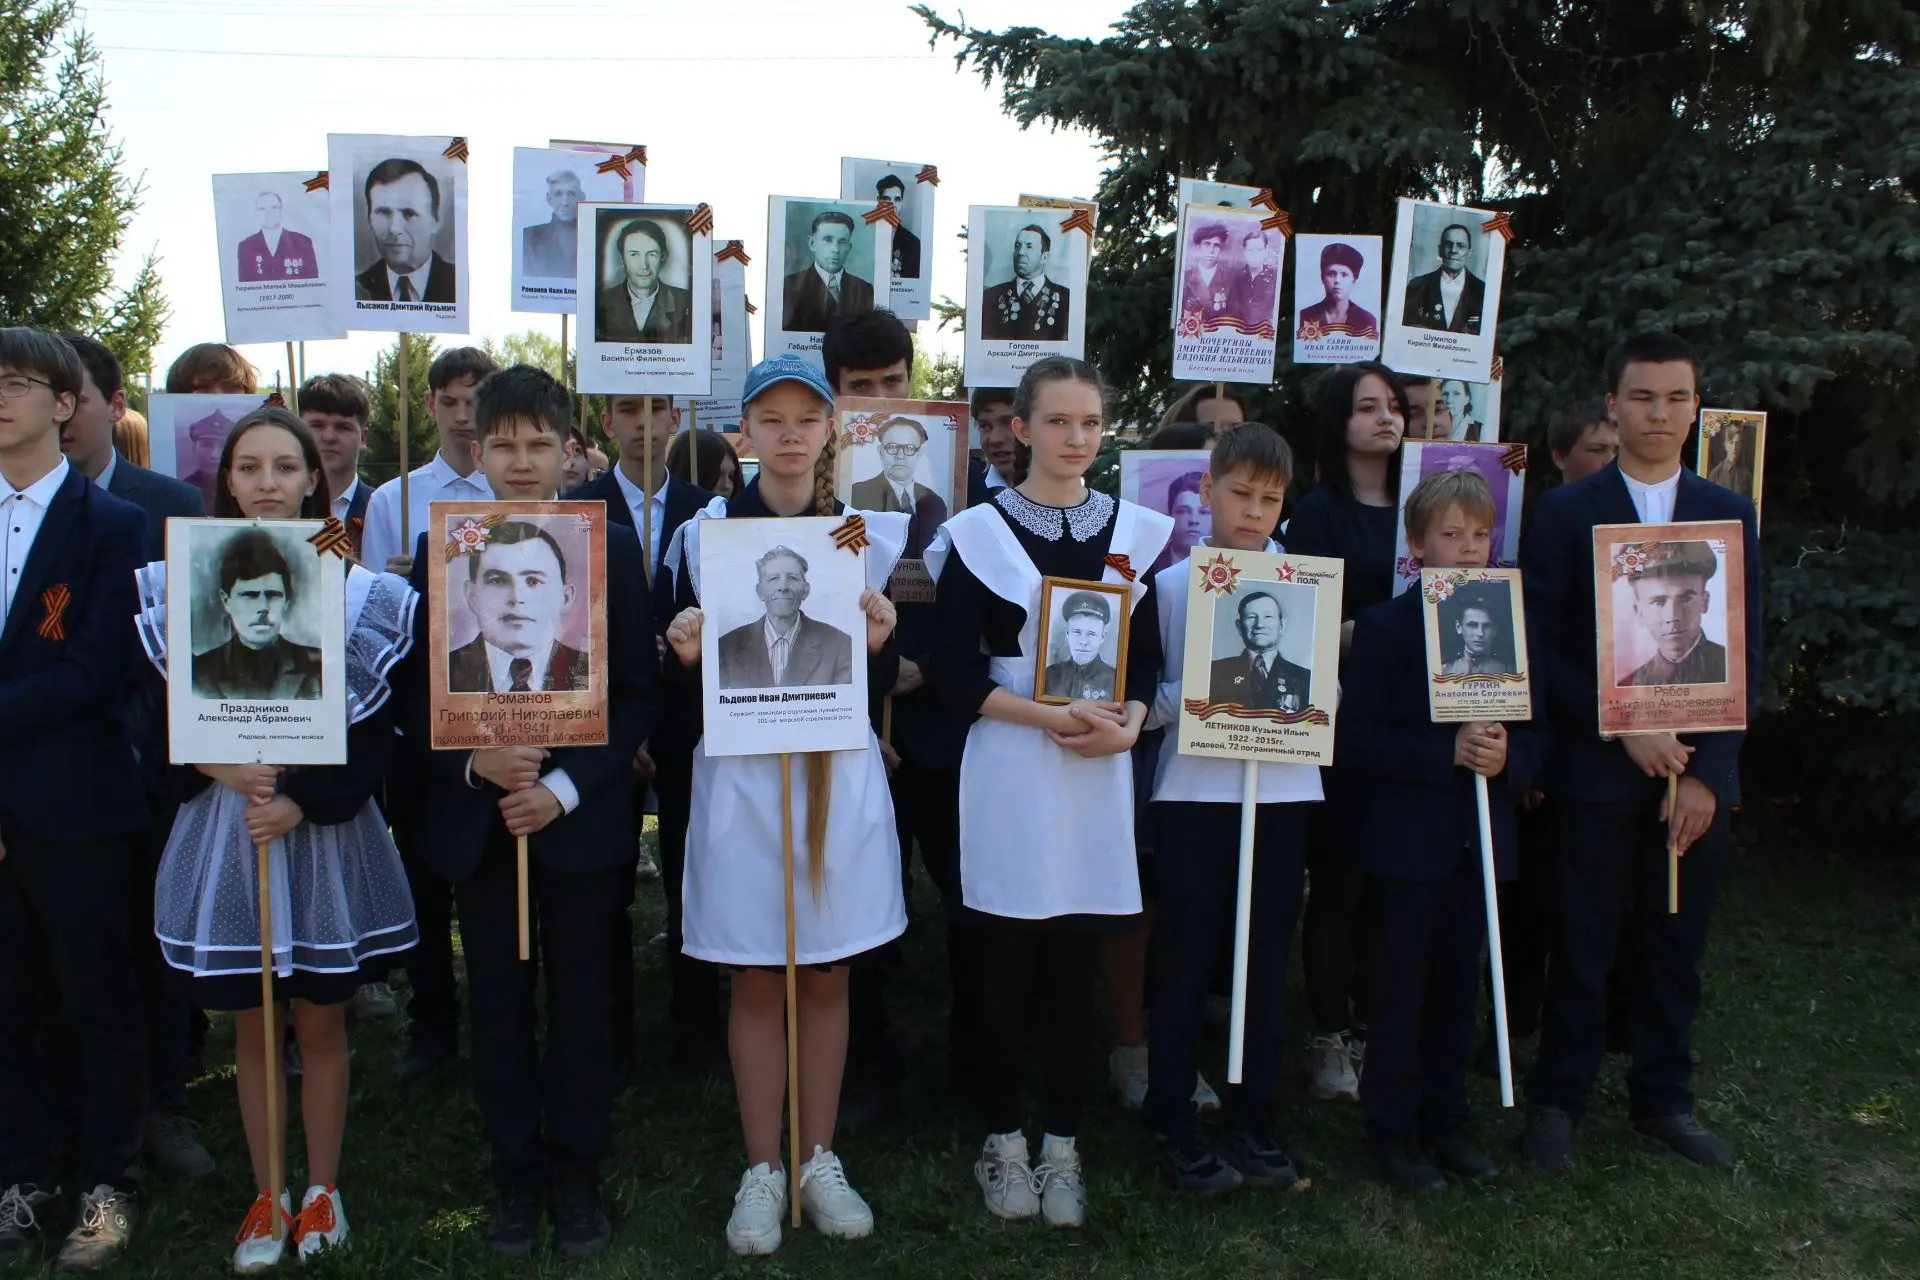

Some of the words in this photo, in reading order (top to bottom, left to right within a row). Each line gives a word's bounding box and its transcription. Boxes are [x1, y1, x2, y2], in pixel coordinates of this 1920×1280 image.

[390, 302, 423, 311] Дмитрий
[424, 303, 456, 312] Кузьмич
[1200, 338, 1252, 347] КОЧЕРГИНЫ
[1424, 334, 1457, 344] Шумилов
[624, 347, 662, 356] Ермазов
[1176, 345, 1220, 353] ДМИТРИЙ
[1222, 347, 1272, 356] МАТВЕЕВИЧ
[1408, 340, 1431, 348] Кирилл
[1432, 342, 1471, 352] Михайлович
[1176, 353, 1216, 362] ЕВДОКИЯ
[1220, 356, 1272, 365] ИЛЬИНИЧНА
[1654, 686, 1690, 696] Рябов
[488, 693, 552, 704] Романов
[719, 695, 757, 704] Льдоков
[759, 694, 779, 702] Иван
[781, 692, 836, 702] Дмитриевич
[220, 704, 289, 714] Праздников
[512, 708, 600, 721] Николаевич
[198, 714, 252, 723] Александр
[255, 714, 312, 723] Абрамович
[1205, 722, 1250, 732] ЛЕТНИКОВ
[1252, 726, 1282, 735] Кузьма
[1284, 729, 1310, 737] Ильич
[435, 734, 479, 745] пропал
[528, 734, 549, 743] под
[553, 731, 605, 742] Москвой
[1228, 734, 1248, 742] 1922
[1255, 737, 1285, 745] 2015гг.
[1191, 741, 1226, 750] рядовой,
[1241, 745, 1295, 754] пограничный
